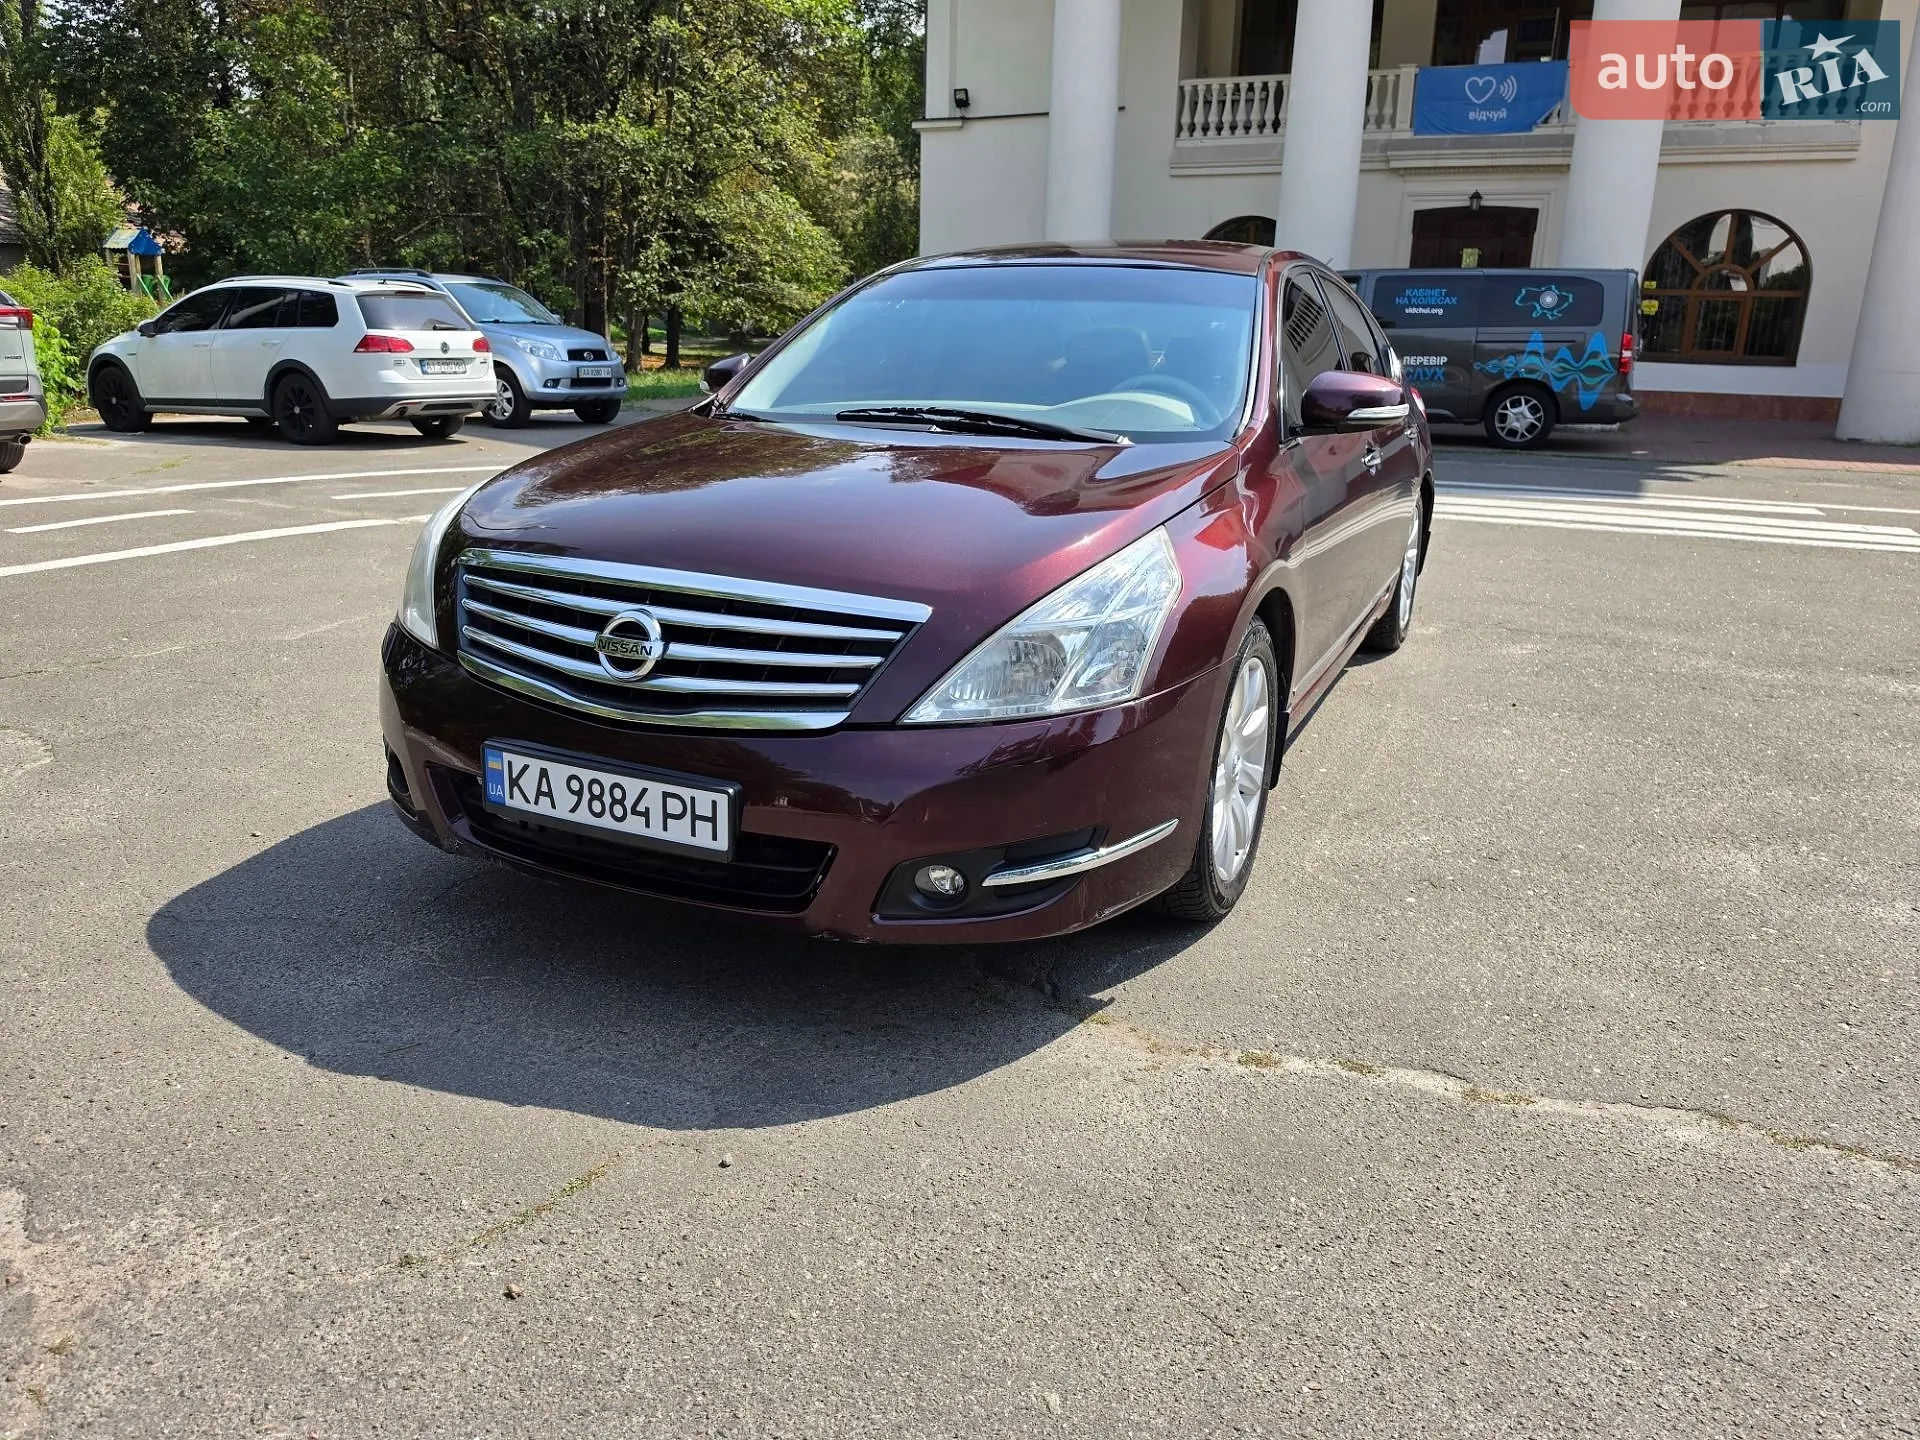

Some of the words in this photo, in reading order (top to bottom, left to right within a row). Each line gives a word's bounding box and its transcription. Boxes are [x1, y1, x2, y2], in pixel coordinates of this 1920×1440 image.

[1468, 107, 1507, 122] відчуй
[1405, 288, 1448, 297] КАБІНЕТ
[1395, 296, 1409, 305] НА
[1411, 296, 1458, 305] КОЛЕСАХ
[1403, 355, 1448, 366] ПЕРЕВІР
[597, 638, 653, 657] NISSAN
[487, 782, 504, 798] UA
[507, 760, 557, 811] KA
[565, 773, 651, 829] 9884
[661, 790, 718, 842] PH
